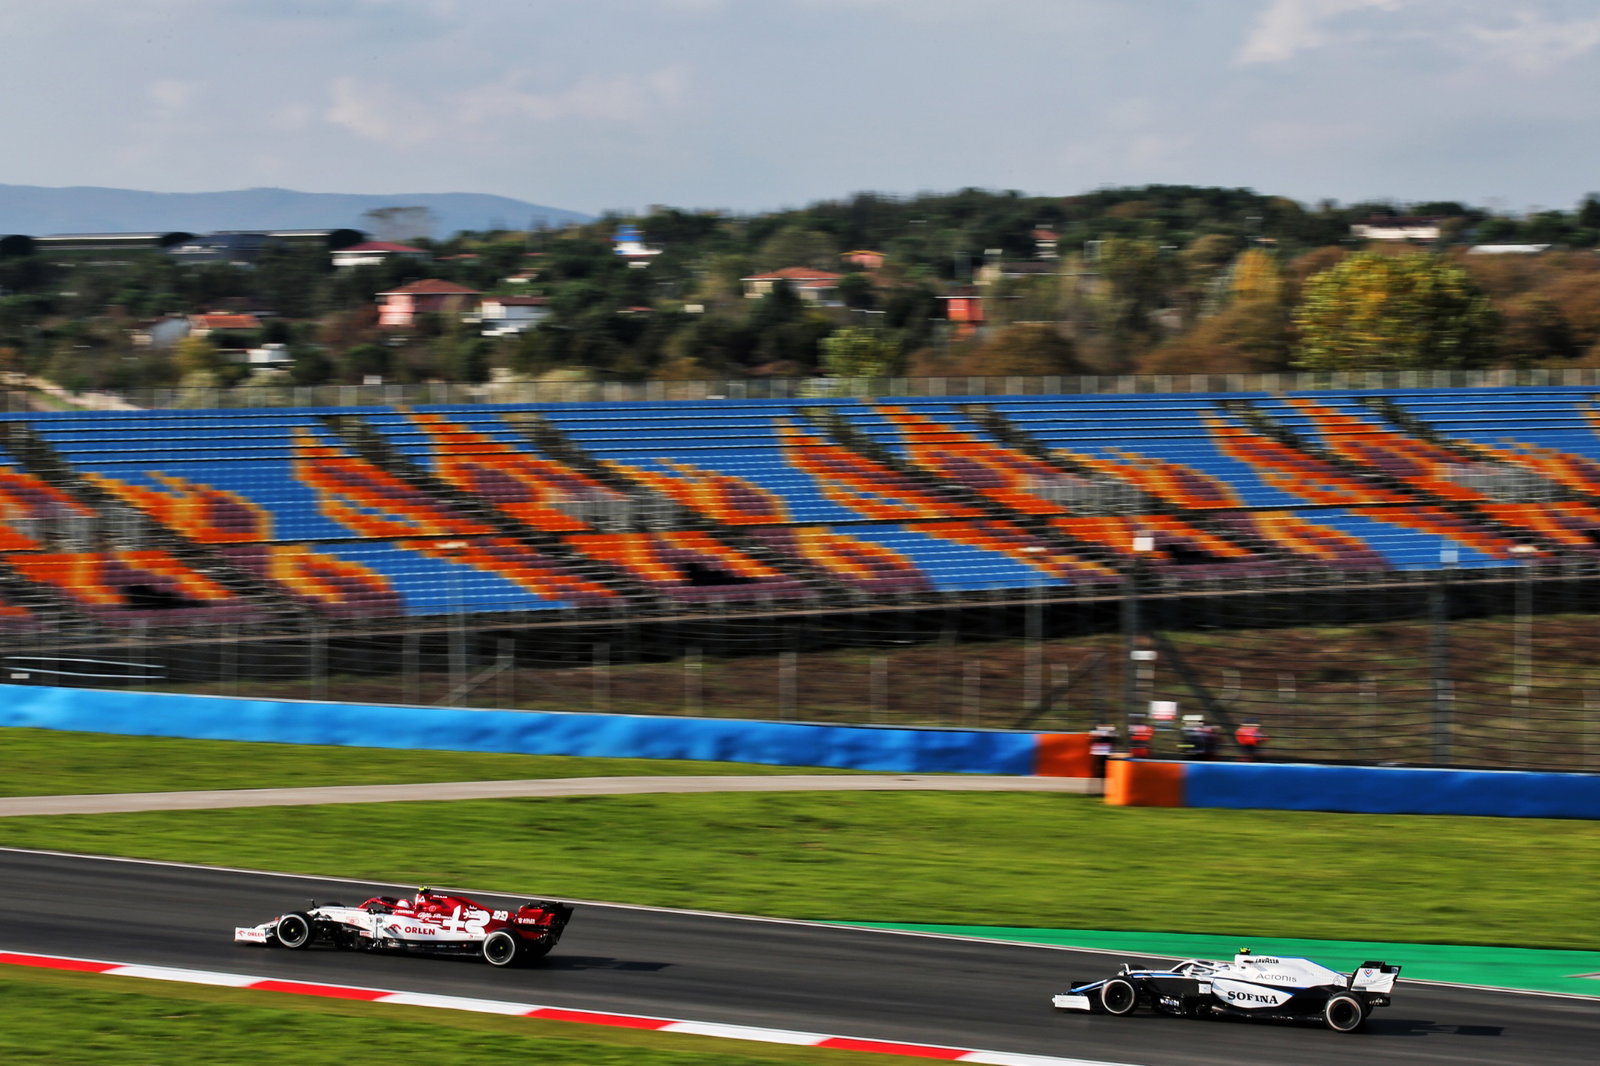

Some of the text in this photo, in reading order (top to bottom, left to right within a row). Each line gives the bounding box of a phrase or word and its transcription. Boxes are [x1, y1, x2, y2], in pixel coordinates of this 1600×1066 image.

[492, 910, 508, 922] 99
[404, 926, 436, 936] ORLEN
[1255, 973, 1297, 983] Acronis
[1227, 991, 1279, 1004] SOFINA
